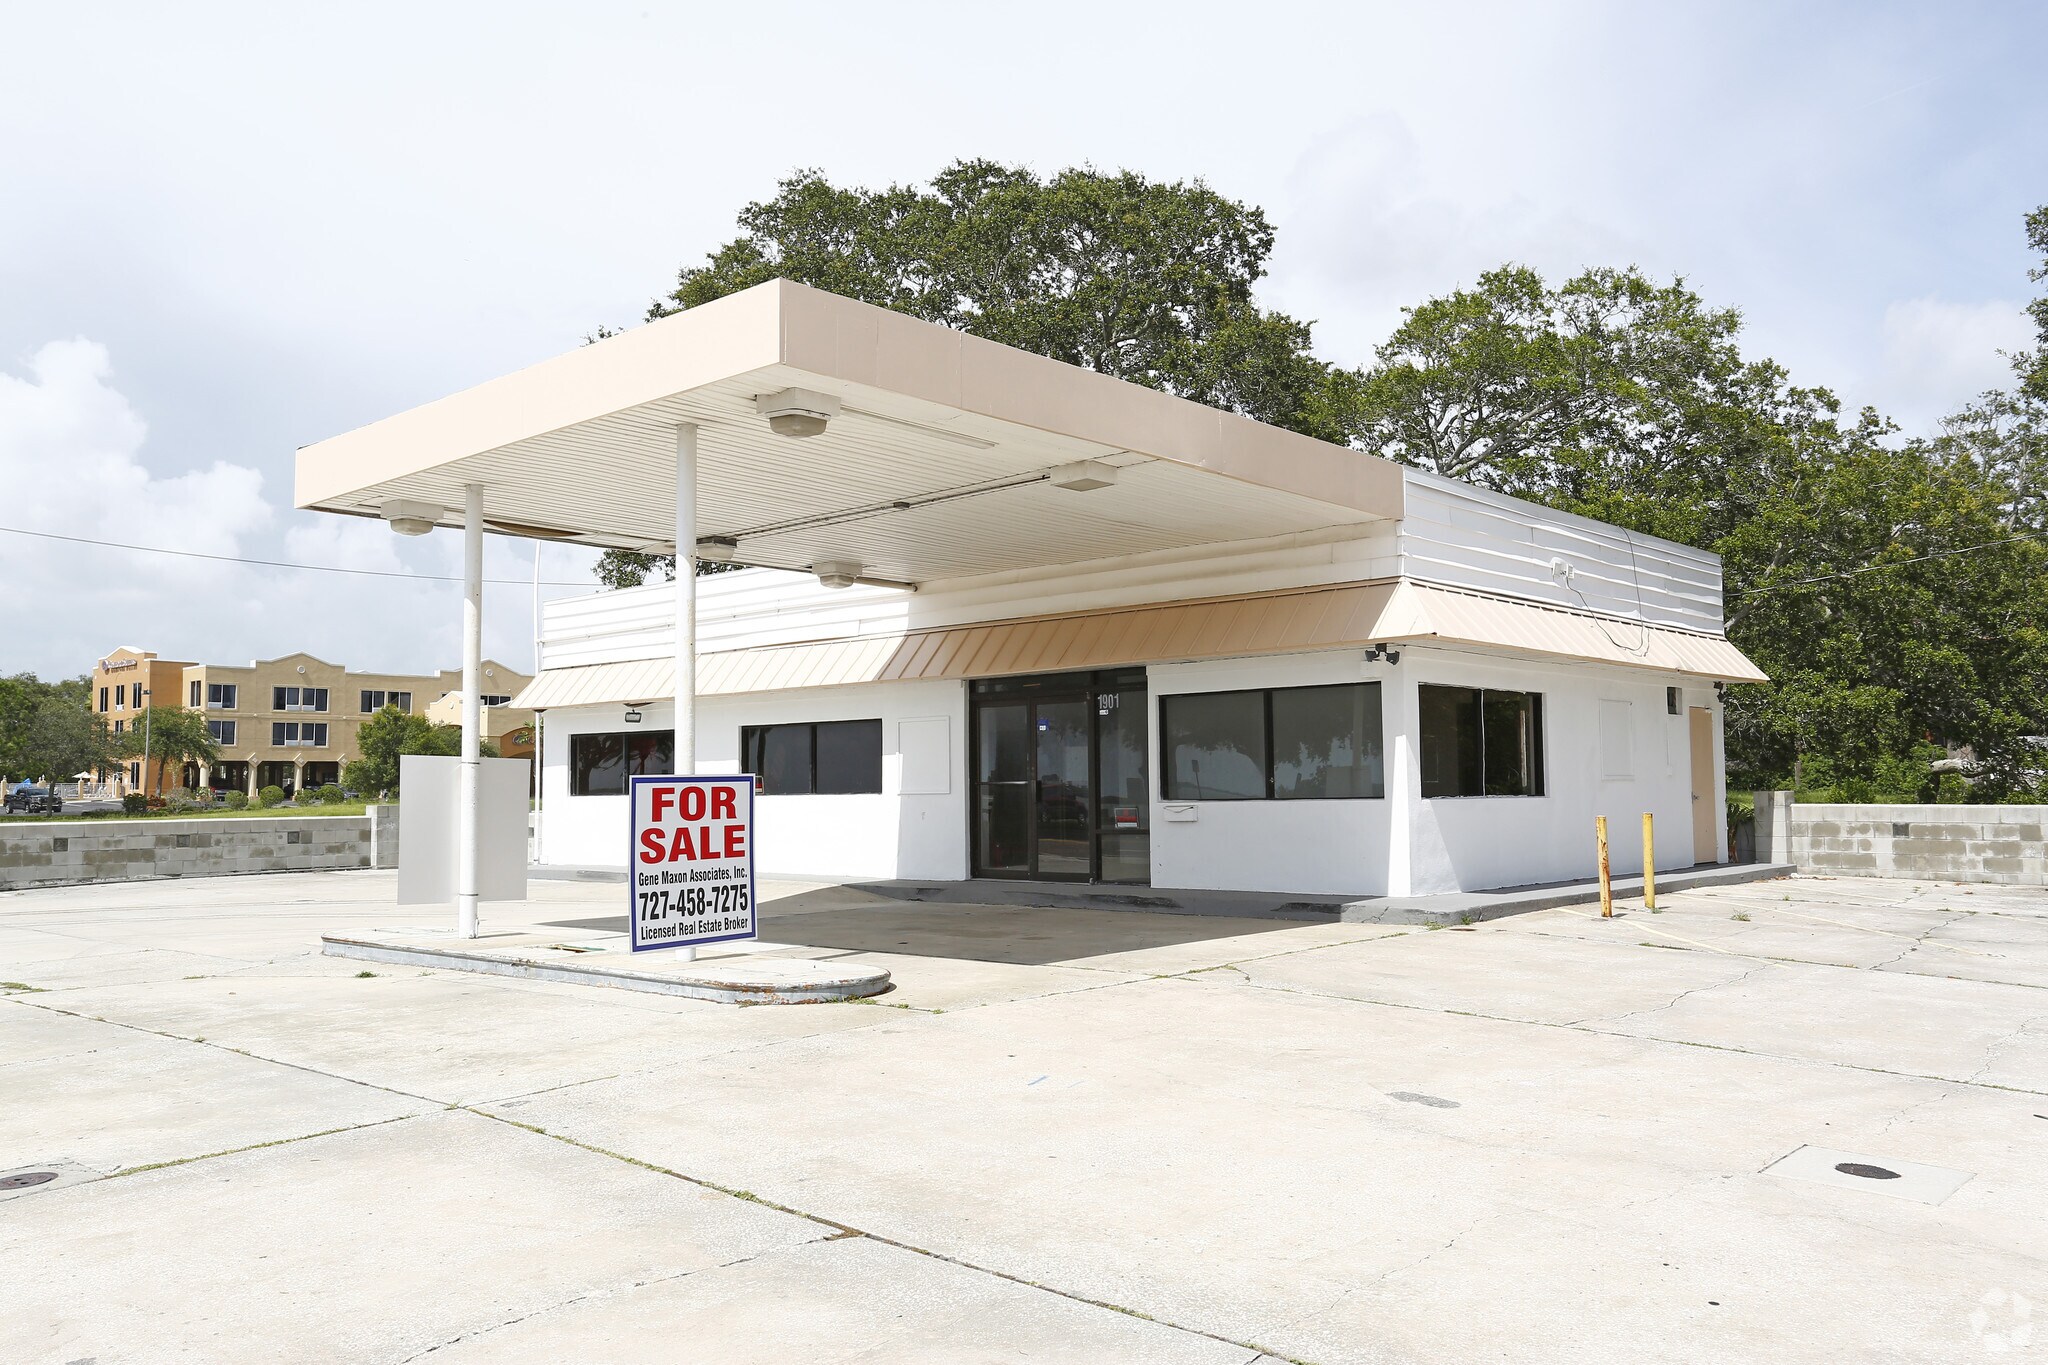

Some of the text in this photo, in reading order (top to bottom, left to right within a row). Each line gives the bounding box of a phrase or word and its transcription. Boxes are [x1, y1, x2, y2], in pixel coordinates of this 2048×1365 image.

[1097, 693, 1119, 709] 1901
[651, 786, 737, 822] FOR
[640, 824, 746, 864] SALE
[638, 865, 748, 886] Gene Maxon Associates, Inc.
[639, 883, 748, 921] 727-458-7275
[641, 916, 748, 940] Licensed Real Estate Broker
